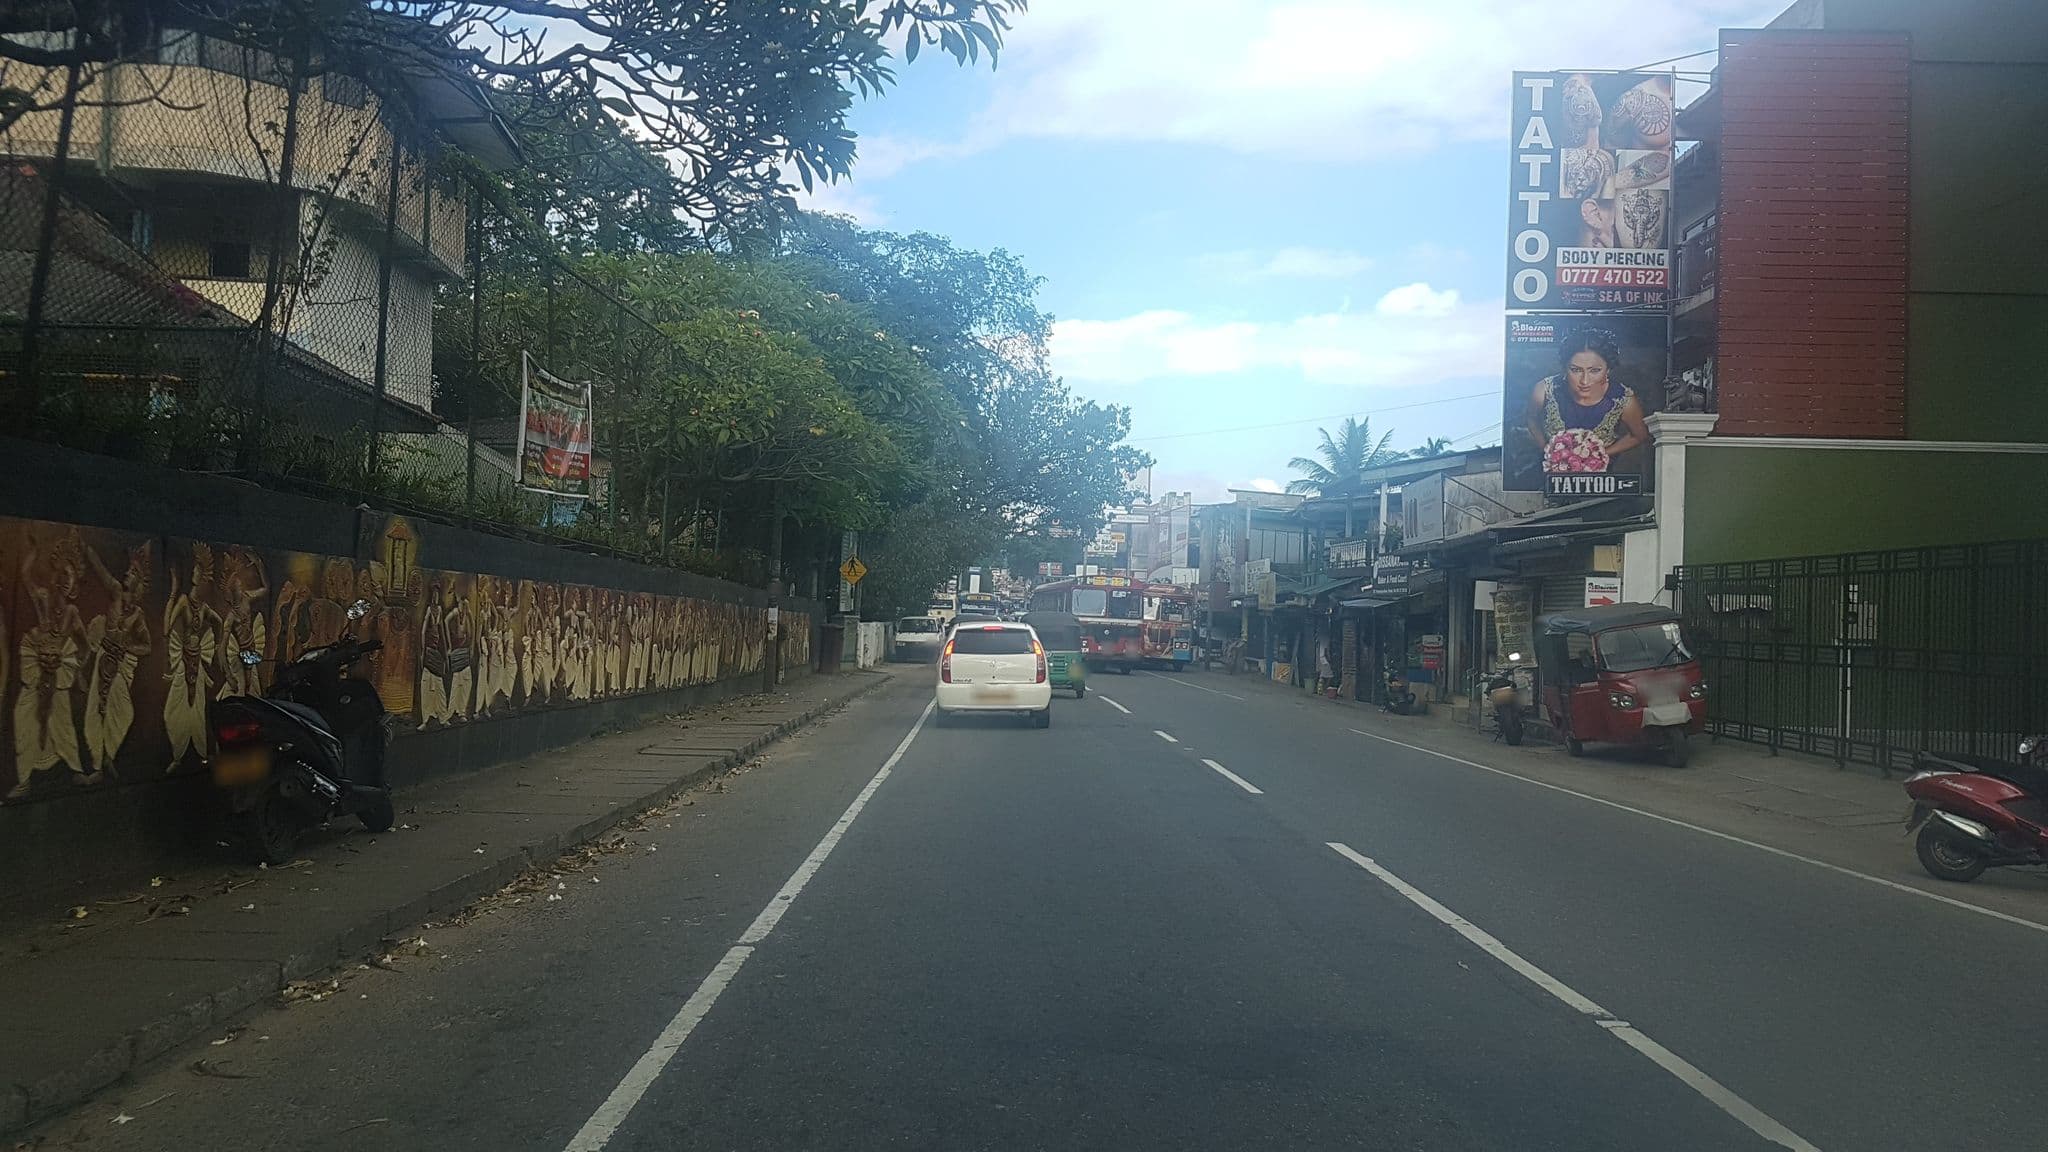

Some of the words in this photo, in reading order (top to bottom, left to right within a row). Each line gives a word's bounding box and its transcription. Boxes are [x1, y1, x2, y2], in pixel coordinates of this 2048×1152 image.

[1513, 78, 1553, 303] TATTOO
[1562, 250, 1600, 265] BODY
[1604, 251, 1665, 266] PIERCING
[1562, 269, 1599, 284] 0777
[1603, 269, 1632, 284] 470
[1636, 270, 1664, 285] 522
[1599, 290, 1622, 303] SEA
[1626, 291, 1641, 303] OF
[1644, 291, 1664, 304] INK
[1551, 476, 1615, 493] TATTOO
